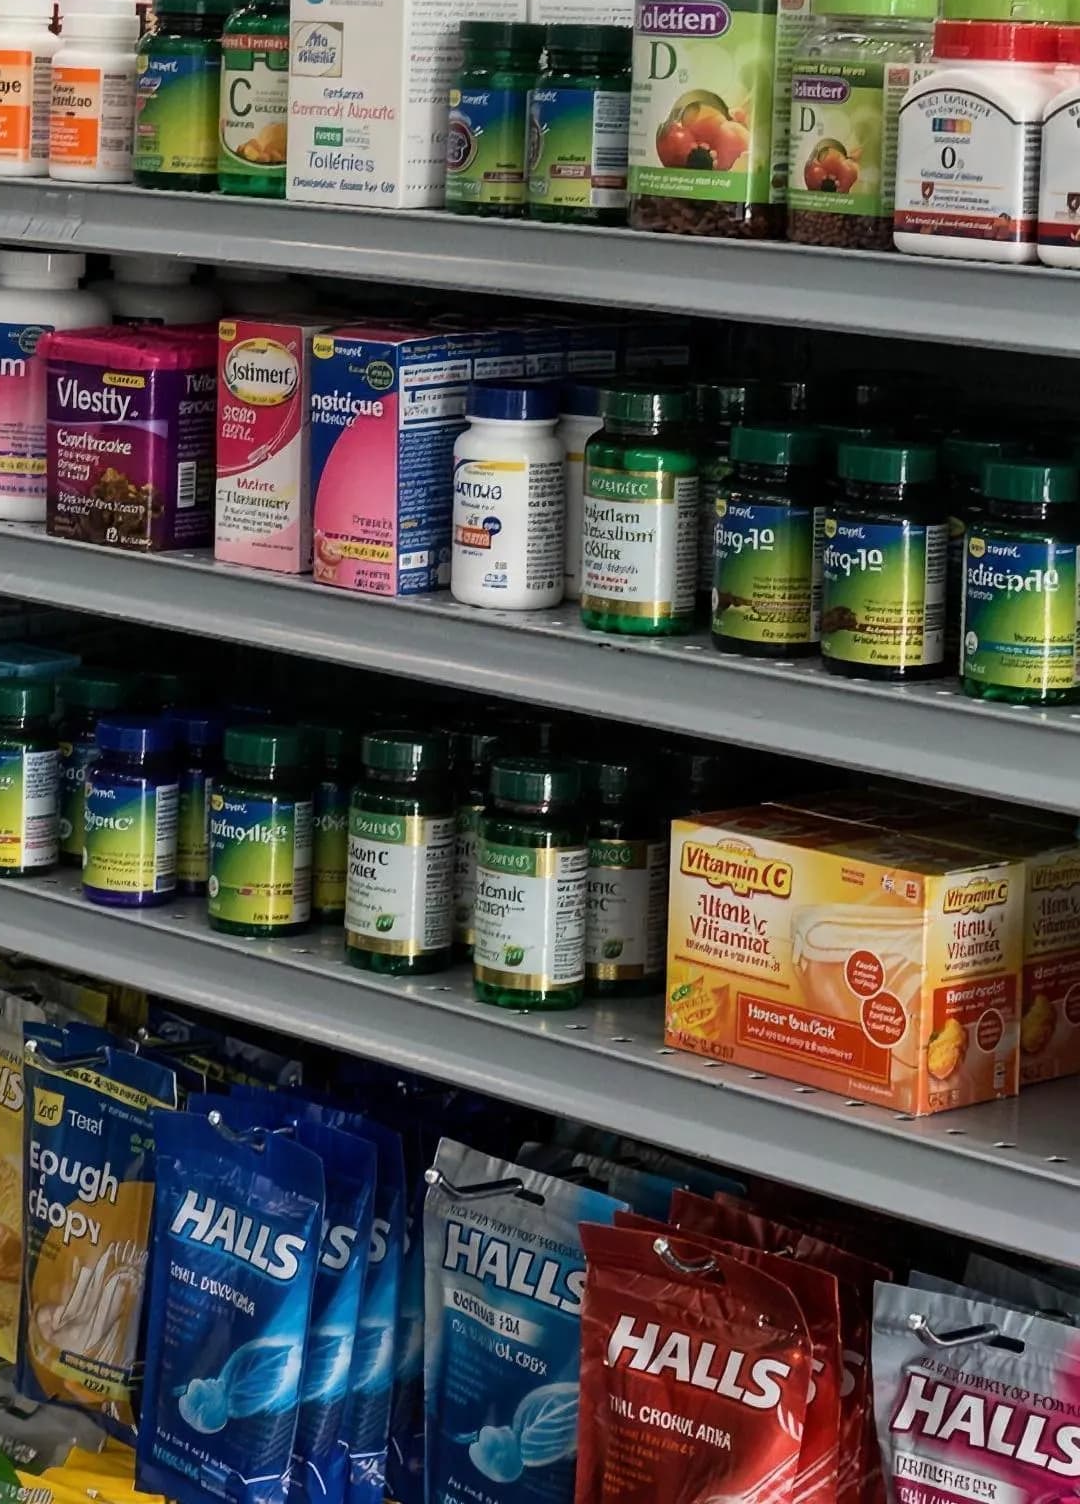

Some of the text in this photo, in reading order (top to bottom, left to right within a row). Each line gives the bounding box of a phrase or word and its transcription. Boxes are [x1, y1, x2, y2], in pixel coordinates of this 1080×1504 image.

[169, 1189, 308, 1281] HALLS
[443, 1223, 588, 1315] HALLS
[608, 1316, 792, 1410] HALLS
[891, 1373, 1080, 1477] HALLS
